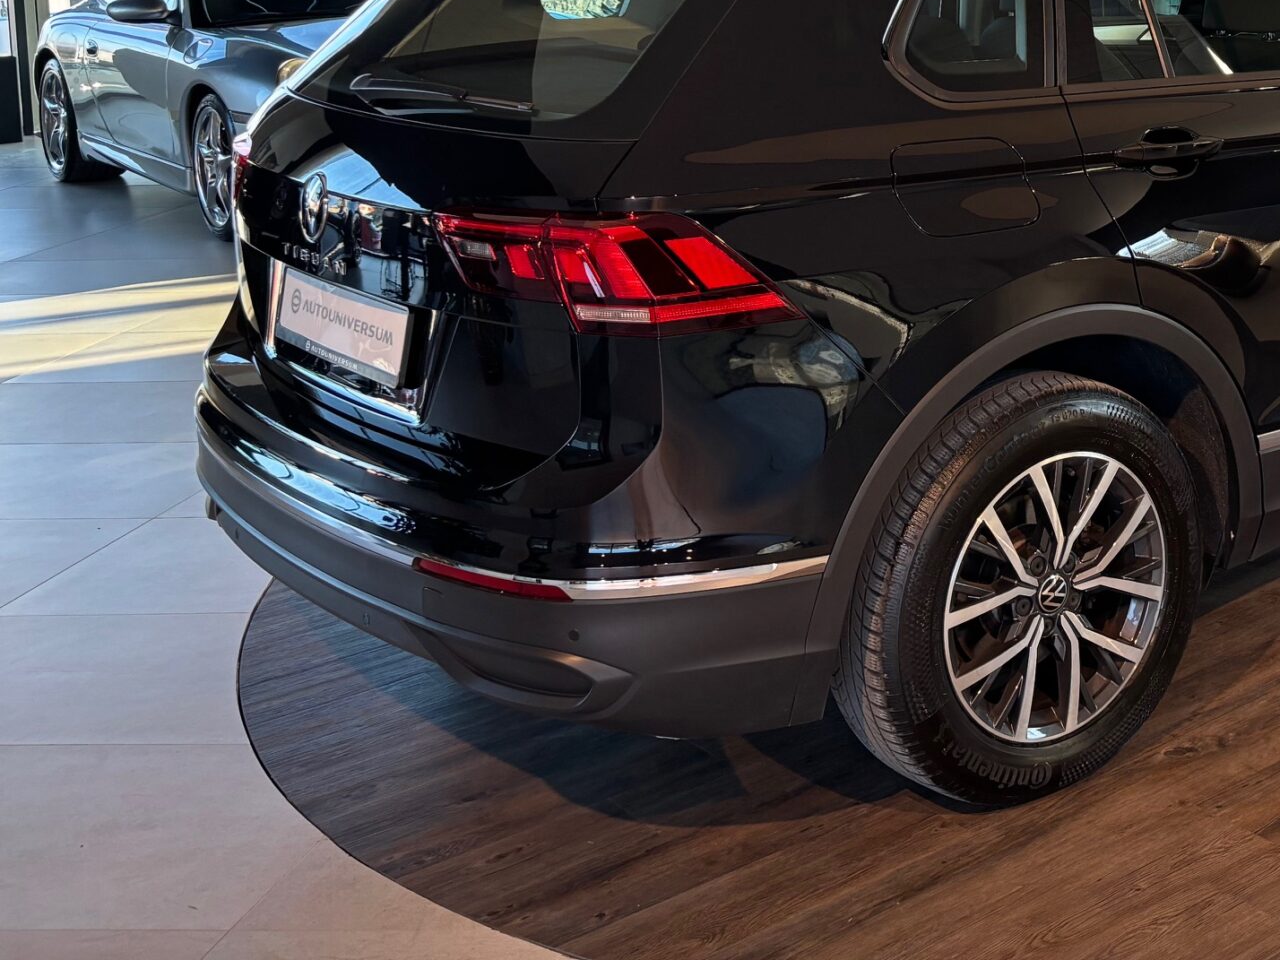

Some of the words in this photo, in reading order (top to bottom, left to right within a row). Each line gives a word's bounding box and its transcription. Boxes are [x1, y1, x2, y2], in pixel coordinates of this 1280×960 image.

[281, 241, 347, 276] TIGUAN
[302, 298, 394, 346] AUTOUNIVERSUM
[310, 344, 359, 371] AUTOUNIVERSUM
